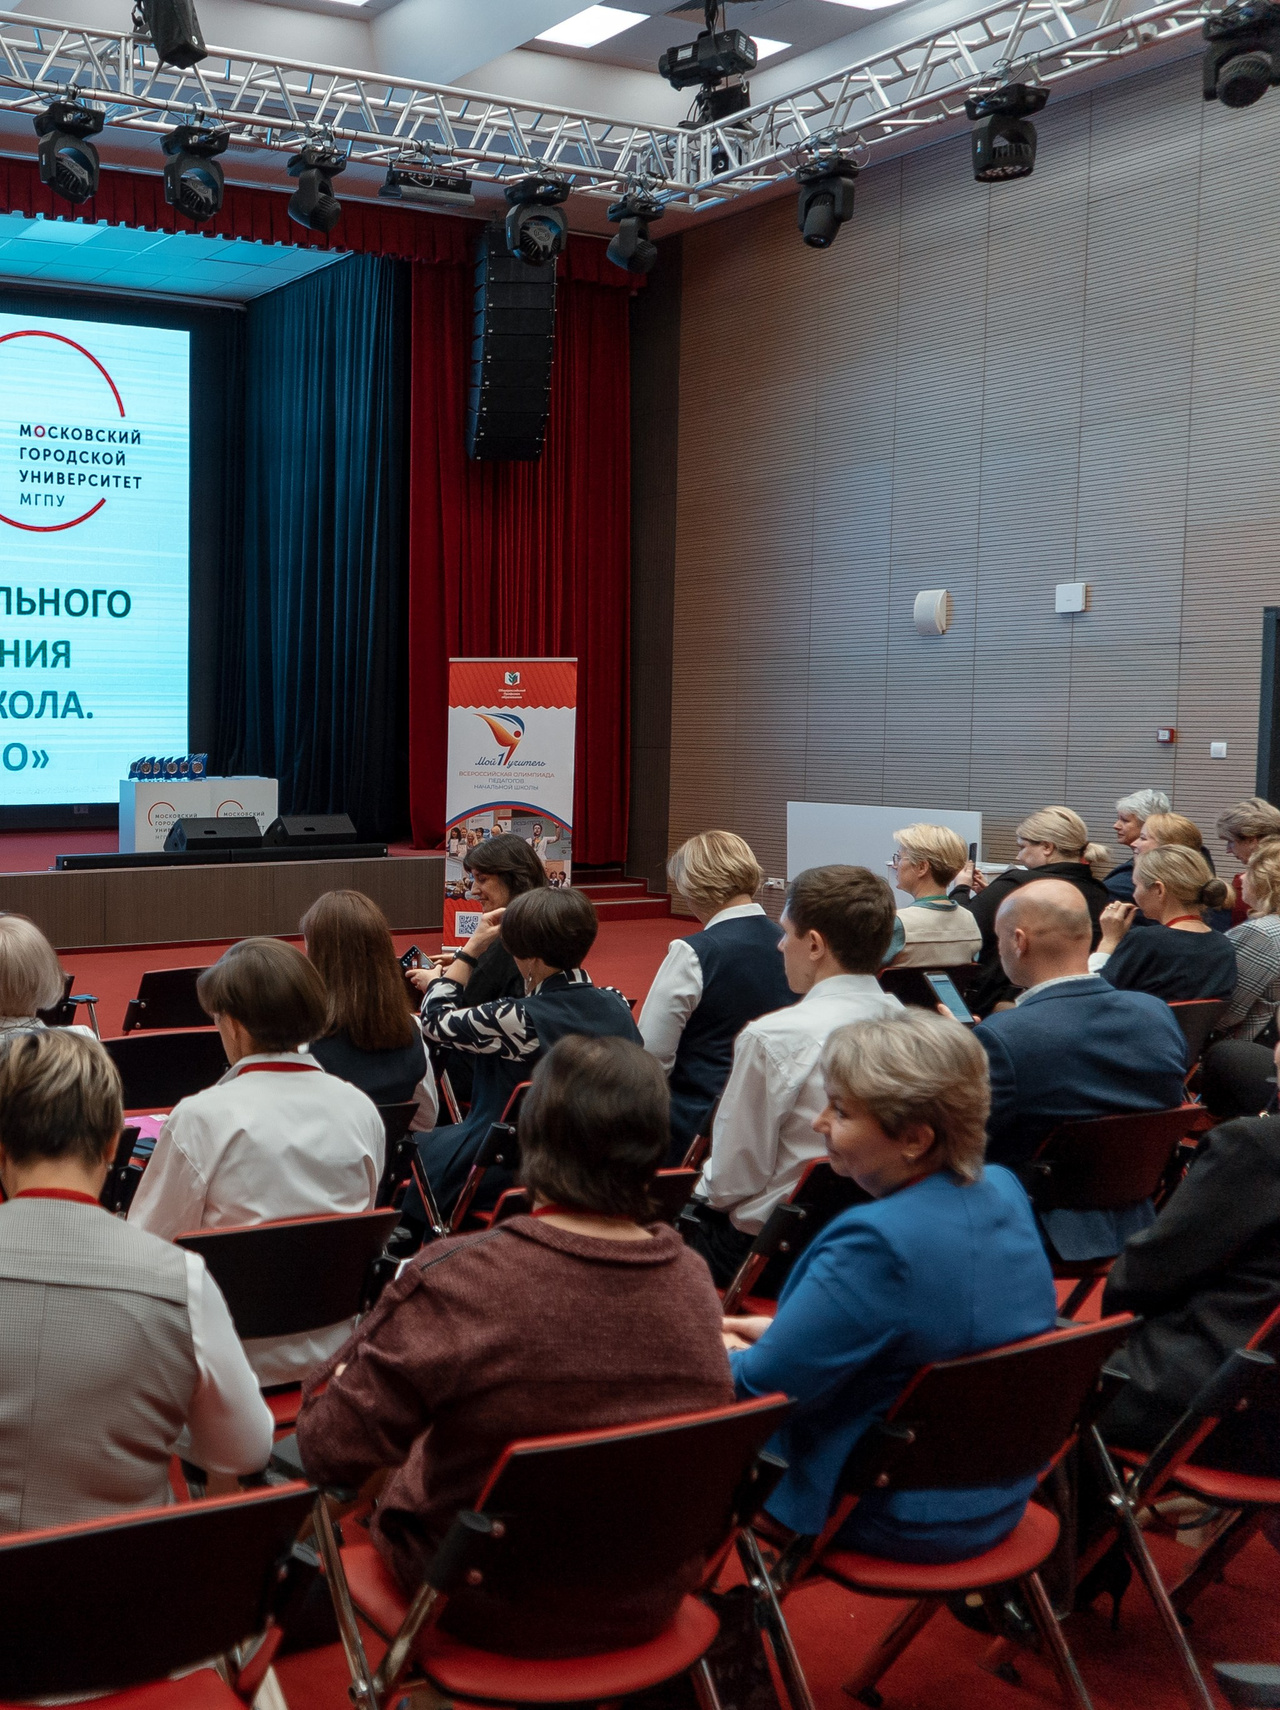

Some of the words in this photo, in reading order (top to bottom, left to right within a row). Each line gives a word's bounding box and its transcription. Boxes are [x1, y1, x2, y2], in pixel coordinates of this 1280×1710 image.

[20, 424, 141, 445] МОСКОВСКИЙ
[20, 447, 126, 466] ГОРОДСКОЙ
[19, 470, 142, 489] УНИВЕРСИТЕТ
[20, 493, 65, 507] МГПУ
